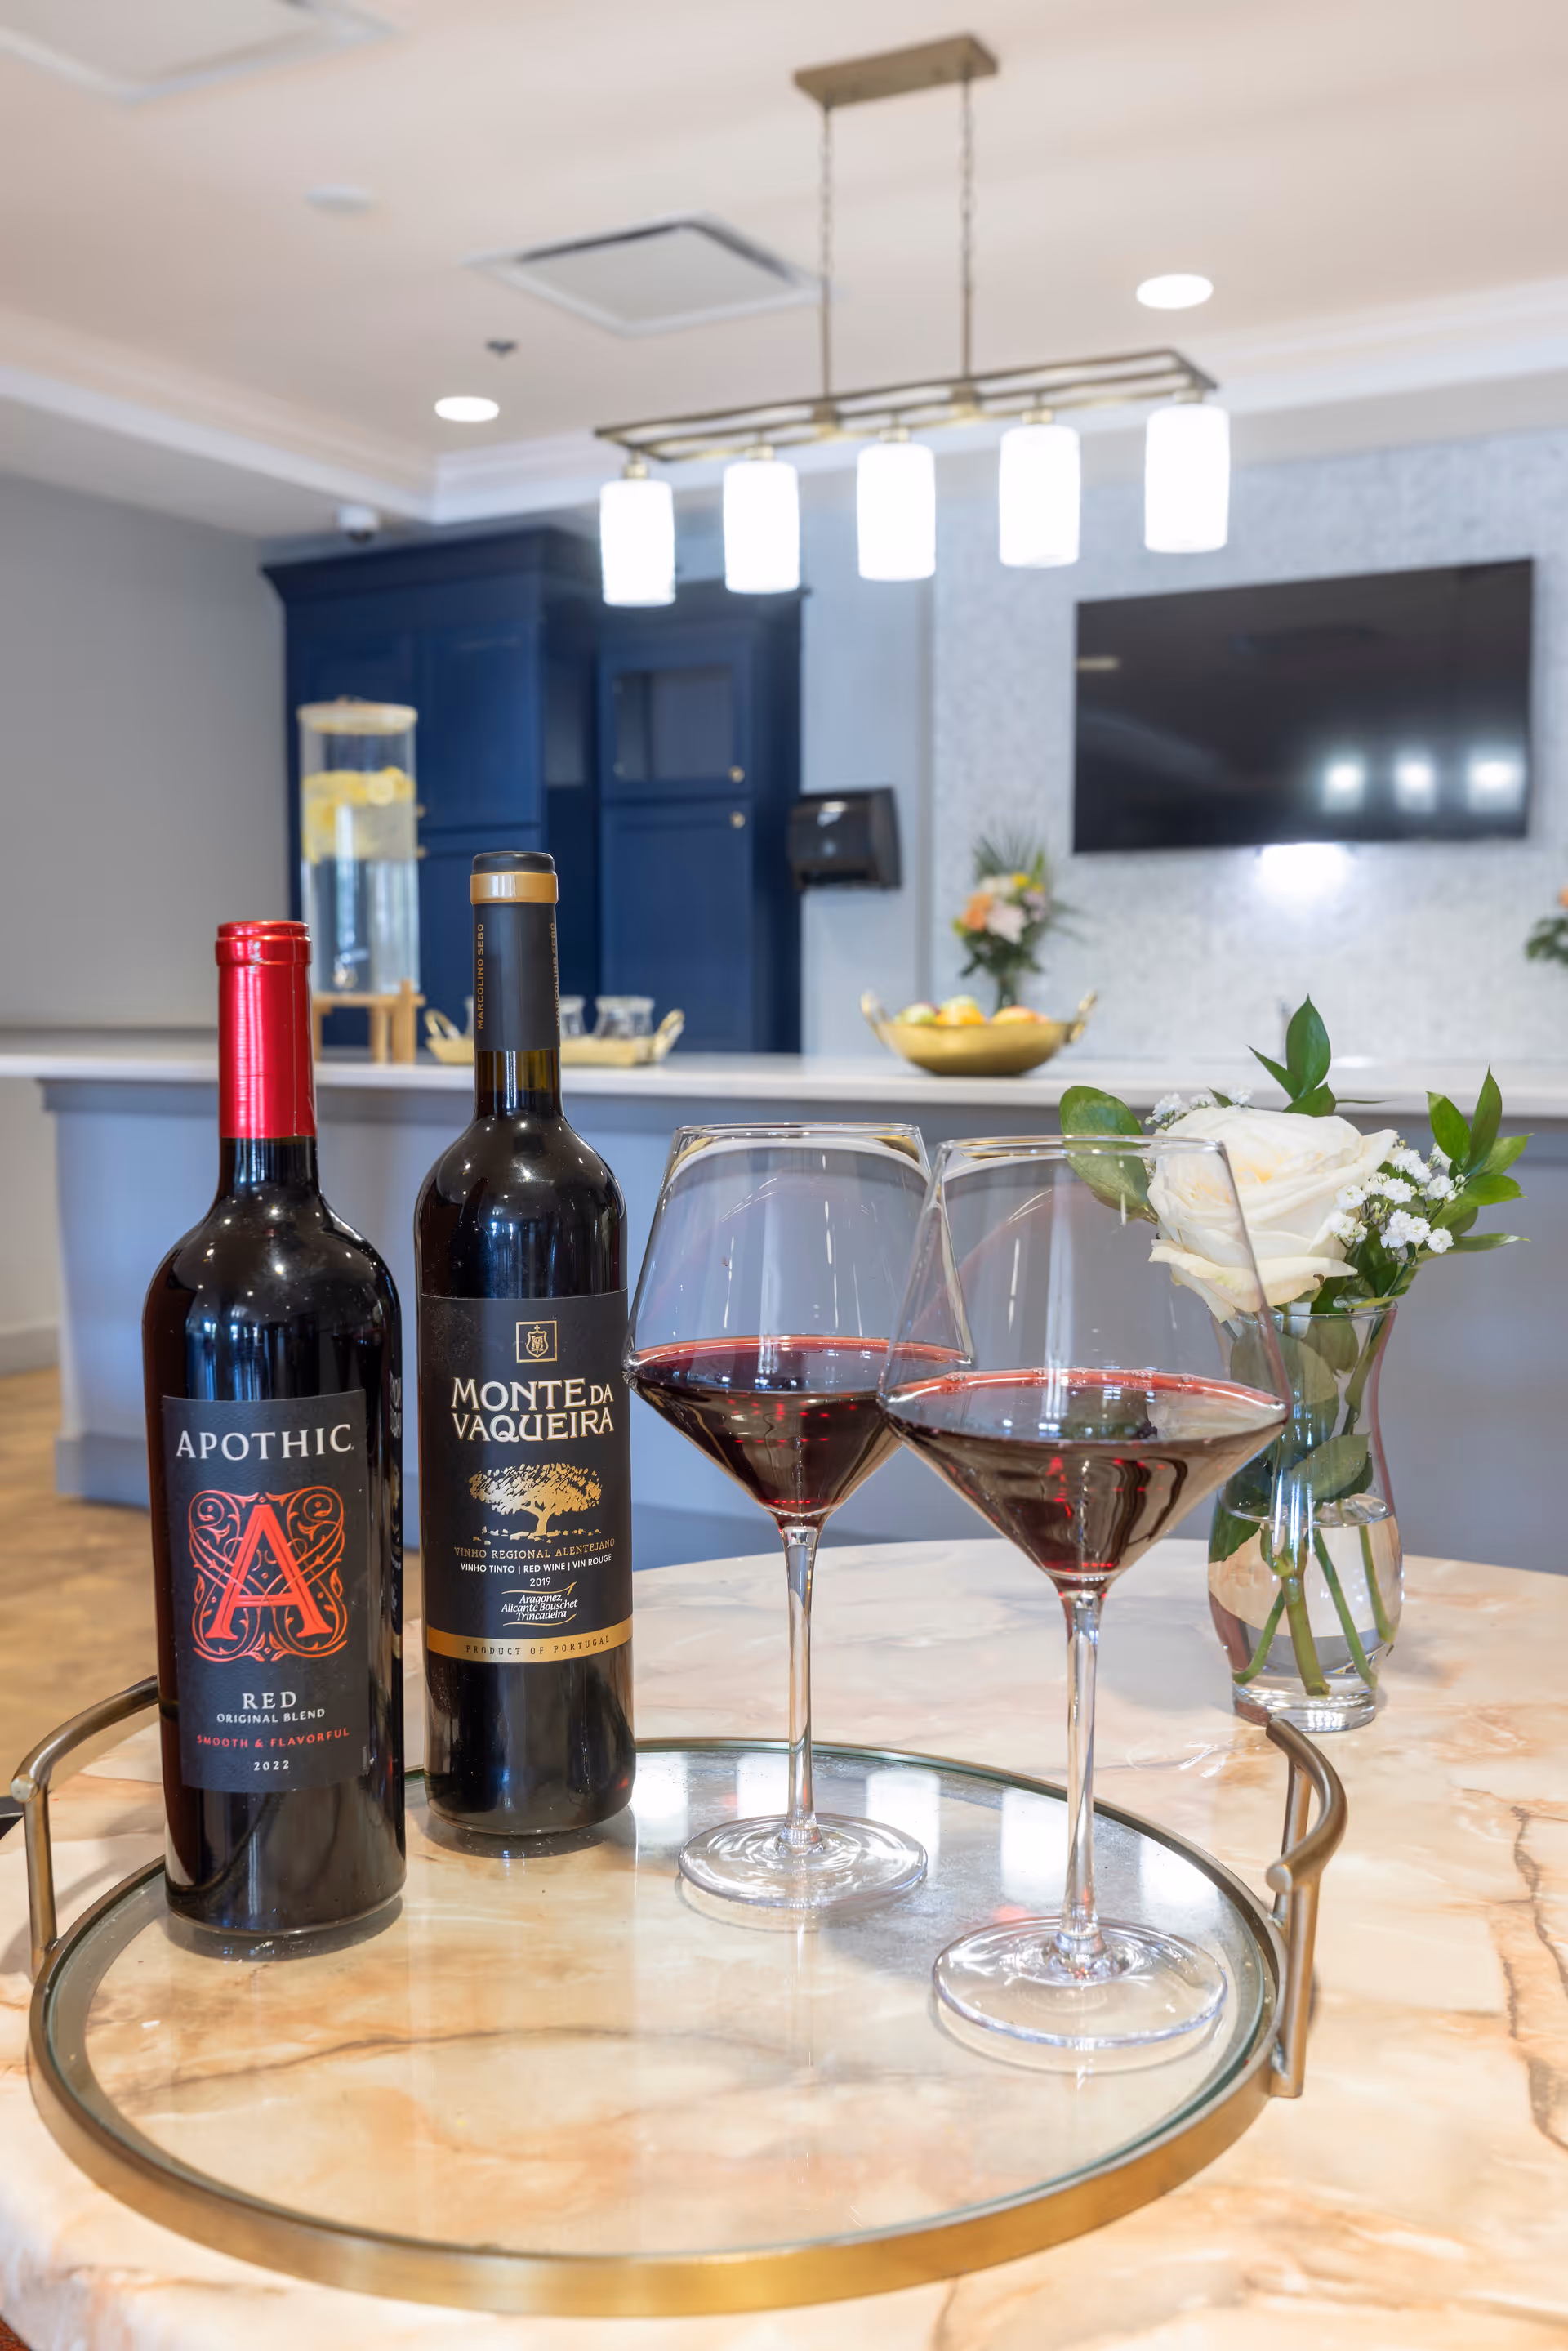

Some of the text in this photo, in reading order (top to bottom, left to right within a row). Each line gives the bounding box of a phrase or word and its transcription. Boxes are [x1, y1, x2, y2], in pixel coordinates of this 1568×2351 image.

[451, 1377, 614, 1412] MONTE DA
[451, 1407, 614, 1443] VAQUEIRA
[176, 1424, 353, 1461] APOTHIC
[454, 1537, 615, 1559] VINHO REGIONAL ALENTEJANO
[204, 1504, 333, 1640] A
[460, 1553, 612, 1573] VINHO TINTO RED WINE VIN ROUGE
[529, 1577, 551, 1586] 2019
[501, 1599, 578, 1613] Alicante Bouschet
[519, 1594, 563, 1605] Aragonez,
[515, 1609, 567, 1621] Trincadeira
[466, 1635, 610, 1655] PRODUCT OF PORTUGAL
[242, 1691, 297, 1710] RED
[216, 1708, 325, 1724] ORIGINAL BLEND
[196, 1727, 350, 1748] SMOOTH & FLAVORFUL
[253, 1760, 290, 1772] 2022
